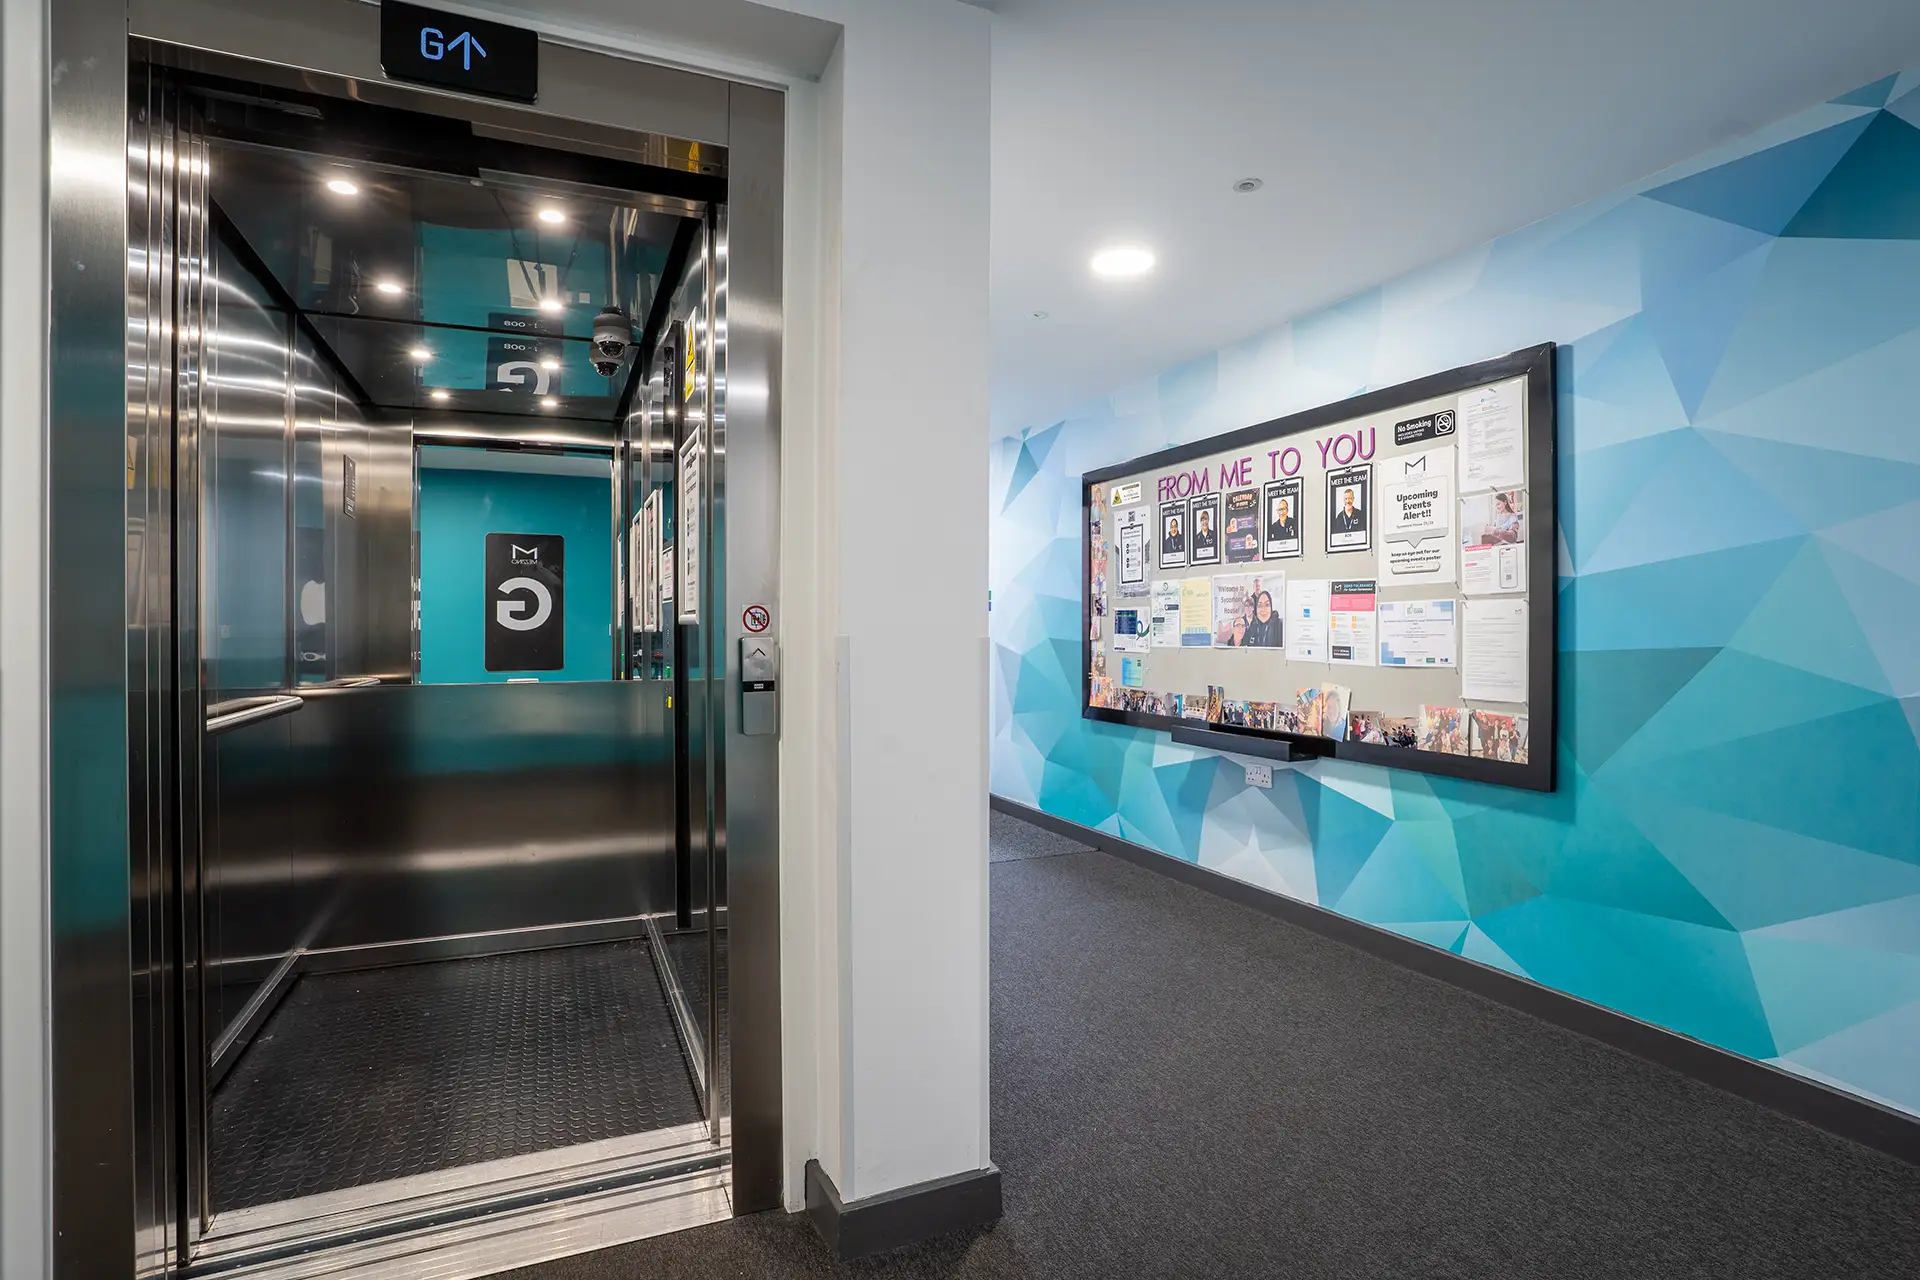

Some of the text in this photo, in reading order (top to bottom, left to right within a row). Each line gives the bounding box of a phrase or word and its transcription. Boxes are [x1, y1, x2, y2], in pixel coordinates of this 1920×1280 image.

[421, 27, 444, 60] G
[1397, 420, 1431, 433] No Smoking
[1157, 467, 1210, 502] FROM
[1219, 457, 1252, 489] ME
[1267, 447, 1301, 479] TO
[1316, 427, 1376, 469] YOU
[1331, 478, 1344, 486] MEET
[1268, 489, 1279, 497] MEET
[1396, 489, 1438, 503] Upcoming
[1403, 500, 1431, 511] Events
[1403, 509, 1431, 521] Alert!!
[1218, 585, 1239, 593] Welcome
